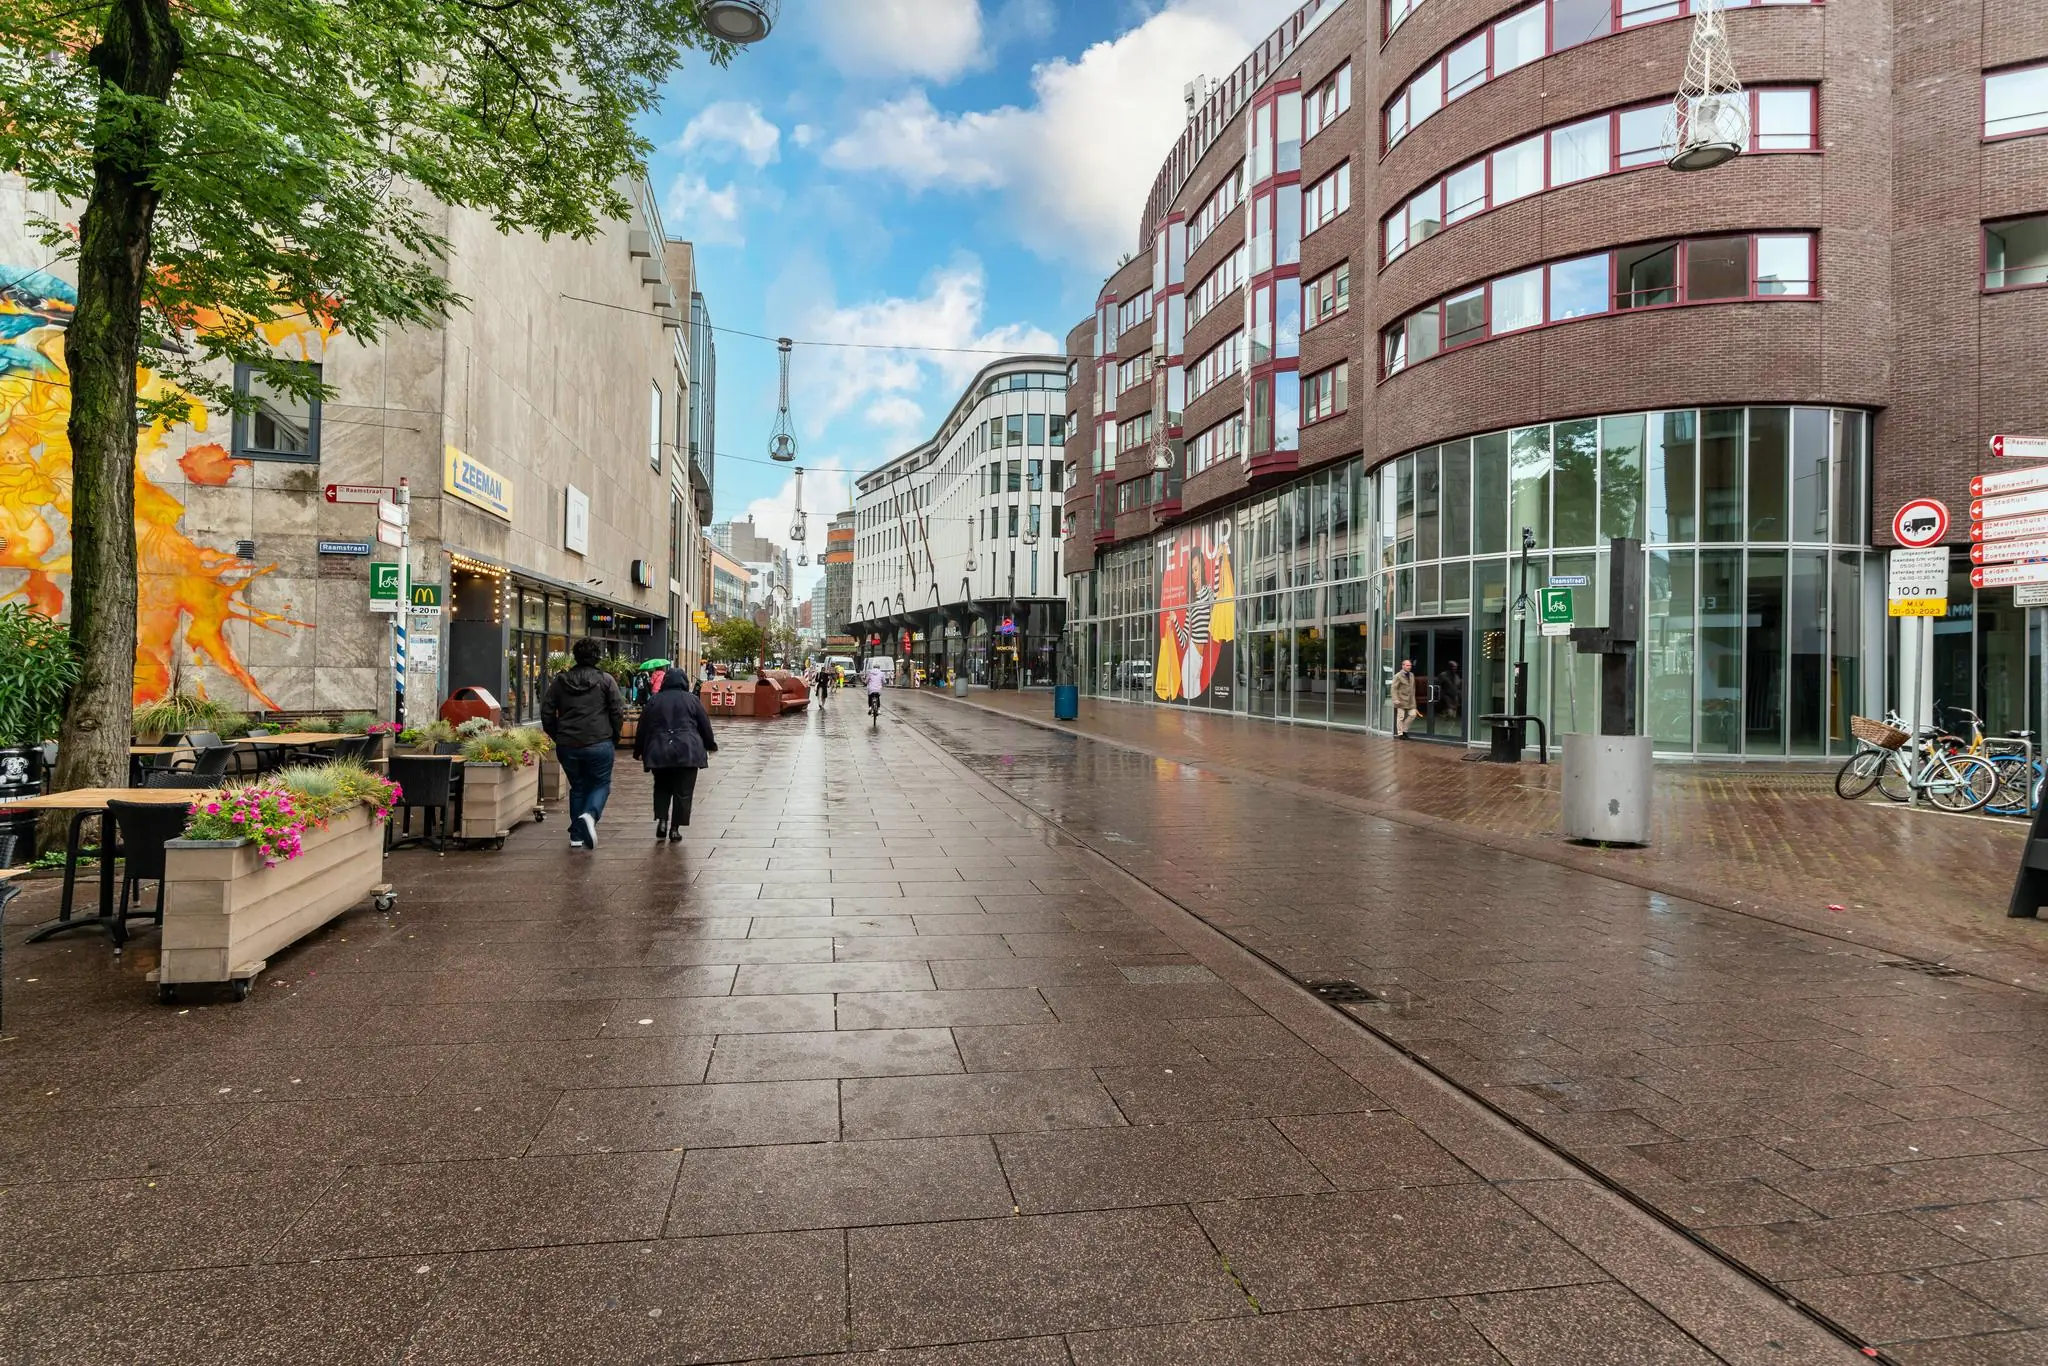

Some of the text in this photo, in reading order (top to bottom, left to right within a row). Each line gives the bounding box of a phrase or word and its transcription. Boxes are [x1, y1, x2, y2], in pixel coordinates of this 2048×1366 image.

[461, 460, 502, 501] ZEEMAN
[1993, 479, 2033, 490] Binnenhof
[345, 487, 382, 495] Raamstraat
[1993, 496, 2028, 506] Stadhuis
[1993, 516, 2041, 527] Mauritshuis
[322, 543, 366, 553] Raamstraat
[1984, 541, 2040, 550] Scheveningen
[1157, 536, 1176, 574] TE
[1984, 550, 2030, 560] Zoetermeer
[1984, 575, 2025, 584] Rotterdam
[1897, 586, 1937, 596] 100 m
